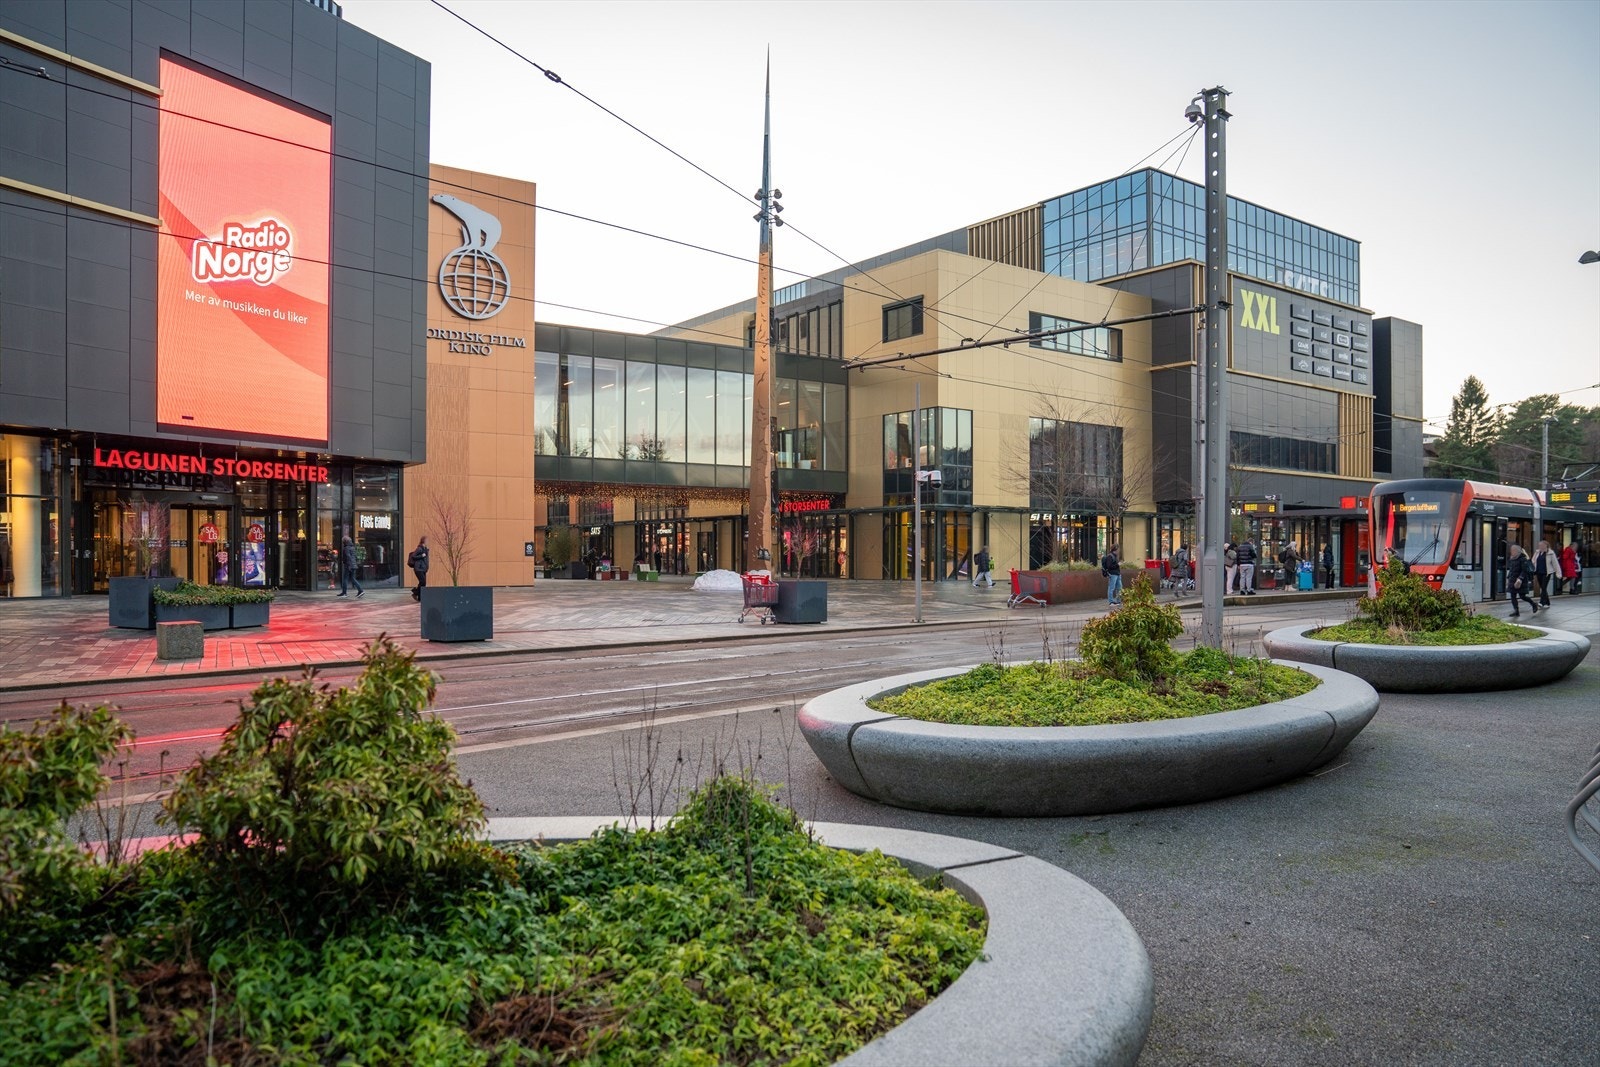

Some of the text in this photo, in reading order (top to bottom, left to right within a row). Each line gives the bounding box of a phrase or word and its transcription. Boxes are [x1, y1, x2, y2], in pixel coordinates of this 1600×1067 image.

[226, 223, 288, 249] Radio
[198, 244, 290, 283] Norge
[185, 289, 308, 325] Mer av musikken du liker
[1240, 288, 1280, 335] XXL
[427, 328, 527, 348] ORDISK FILM
[449, 341, 492, 356] KINO
[94, 447, 328, 483] LAGUNEN STORSENTER
[784, 499, 830, 513] STORSENTER
